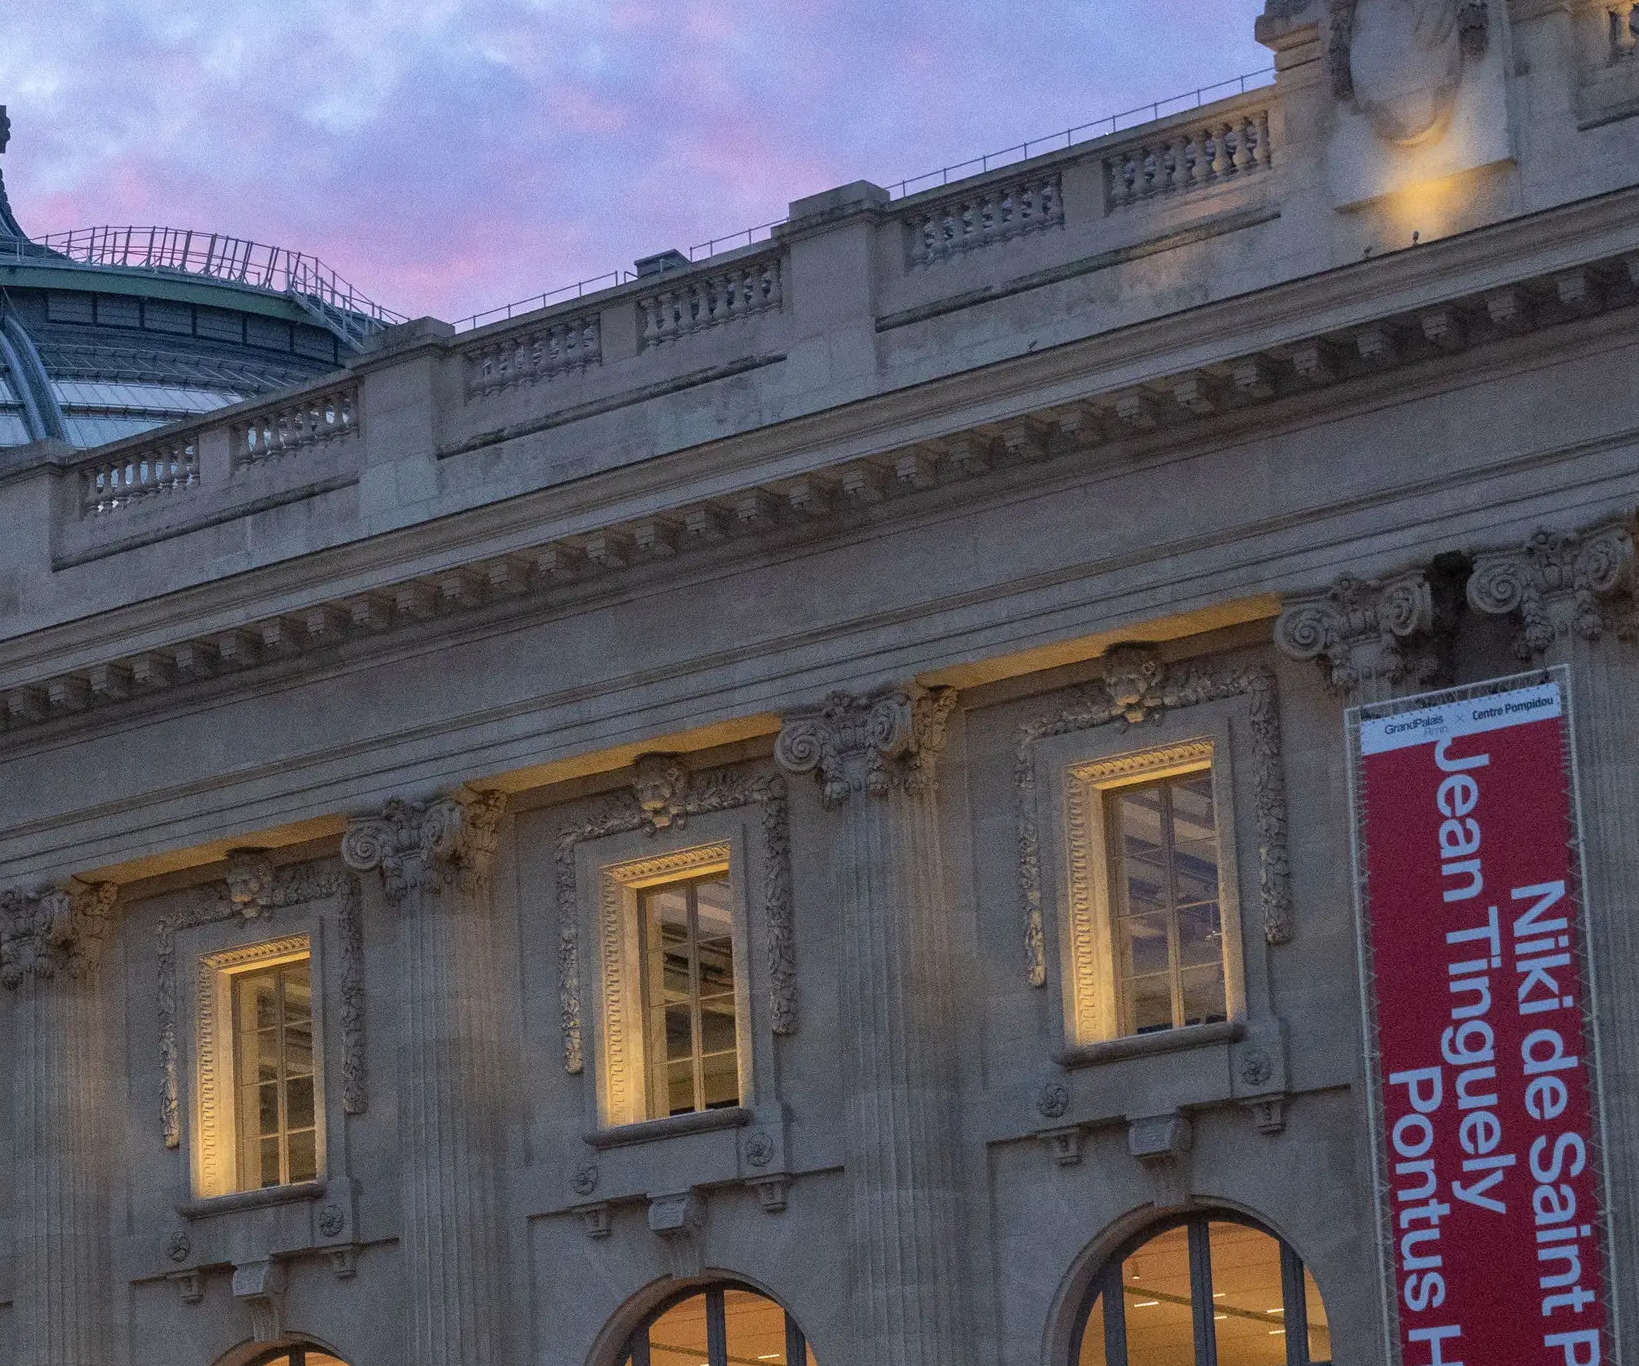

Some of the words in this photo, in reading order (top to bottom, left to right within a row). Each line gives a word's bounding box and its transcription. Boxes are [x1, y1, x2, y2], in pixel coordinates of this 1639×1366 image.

[1384, 714, 1444, 735] GrandPalais
[1472, 707, 1504, 721] Centre
[1505, 696, 1554, 715] Pompidou
[1435, 734, 1490, 903] Jean
[1511, 880, 1574, 1015] Niki
[1441, 906, 1517, 1214] Tinguely
[1522, 1028, 1579, 1121] de
[1389, 1066, 1451, 1312] Pontus
[1529, 1132, 1596, 1316] Saint
